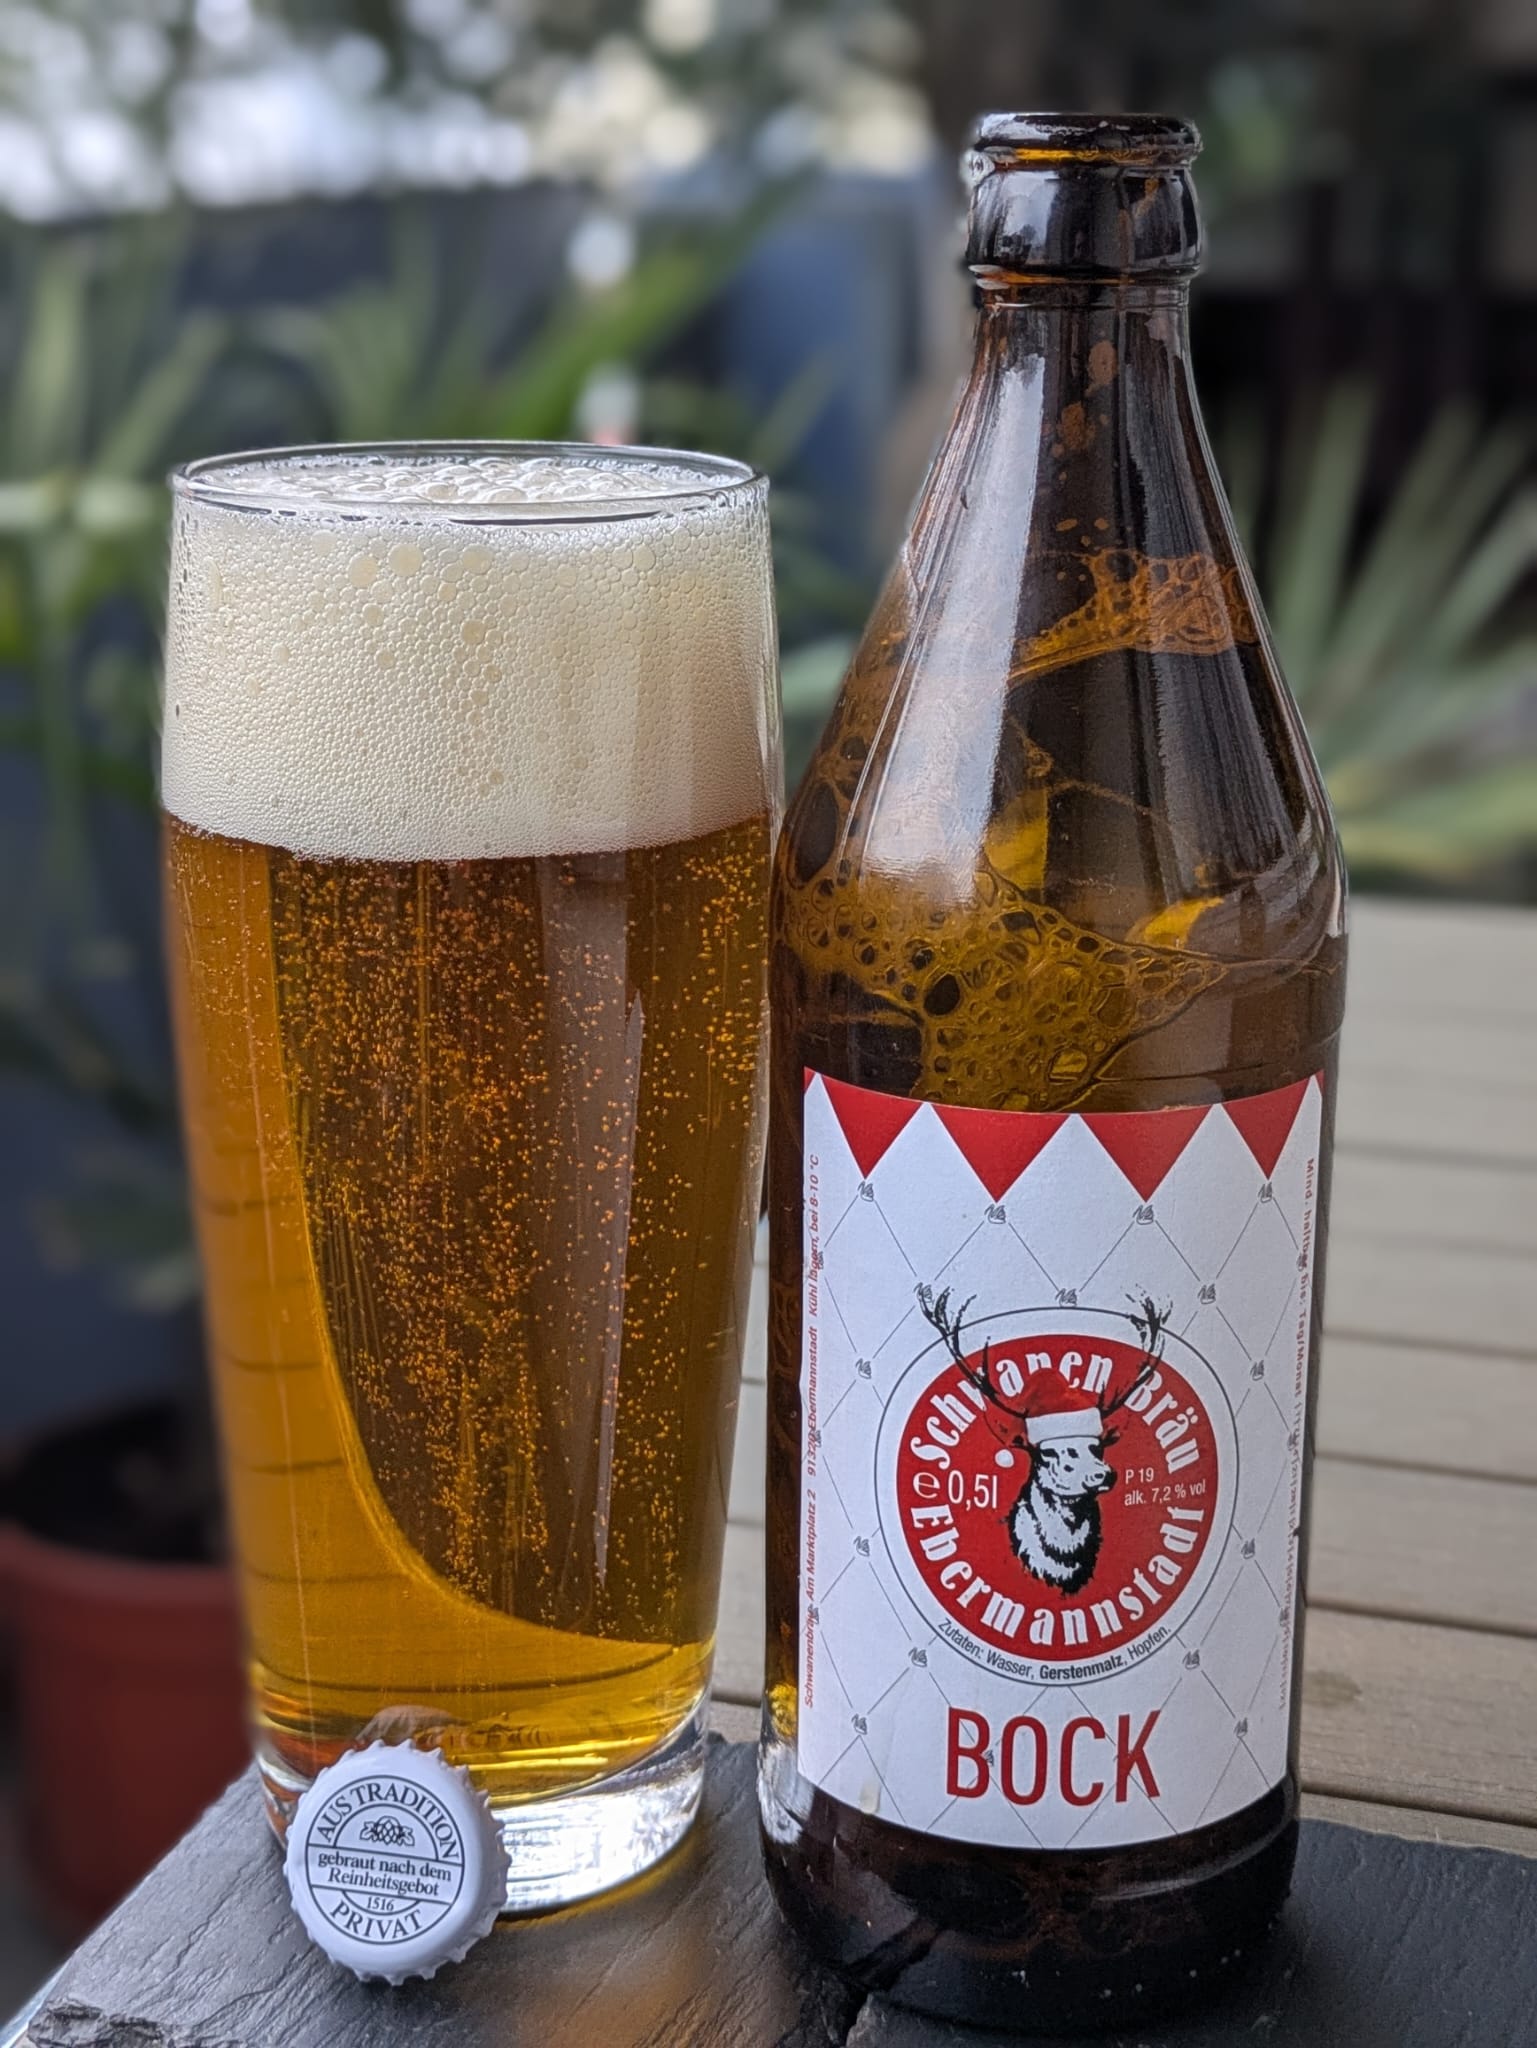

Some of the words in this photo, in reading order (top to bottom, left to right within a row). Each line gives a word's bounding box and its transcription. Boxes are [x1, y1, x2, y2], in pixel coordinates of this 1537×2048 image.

[809, 1175, 819, 1207] 8-10
[808, 1209, 818, 1232] bei
[808, 1285, 818, 1317] Kühl
[807, 1325, 818, 1430] Ebermannstadt
[1124, 1365, 1201, 1475] Bräu
[1125, 1469, 1135, 1485] P
[1138, 1467, 1154, 1483] 19
[806, 1489, 816, 1500] 2
[1124, 1489, 1147, 1506] alk.
[1151, 1485, 1171, 1504] 7,2
[1174, 1483, 1186, 1498] %
[1189, 1479, 1206, 1496] vol
[805, 1502, 817, 1575] Marktplatz
[805, 1578, 815, 1601] Am
[911, 1504, 1204, 1646] Ebermannstadt
[938, 1617, 985, 1660] Zutaten:
[986, 1649, 1035, 1681] Wasser,
[1039, 1653, 1127, 1681] Gerstenmalz,
[1127, 1624, 1172, 1660] Hopfen.
[946, 1706, 1162, 1807] BOCK
[317, 1793, 353, 1843] AUS
[350, 1782, 460, 1860] TRADITION
[317, 1851, 376, 1871] gebraut
[378, 1859, 416, 1876] nach
[419, 1862, 452, 1882] dem
[328, 1866, 440, 1897] Reinheitsgebot
[330, 1899, 422, 1940] PRIVAT
[366, 1896, 395, 1912] 1516
